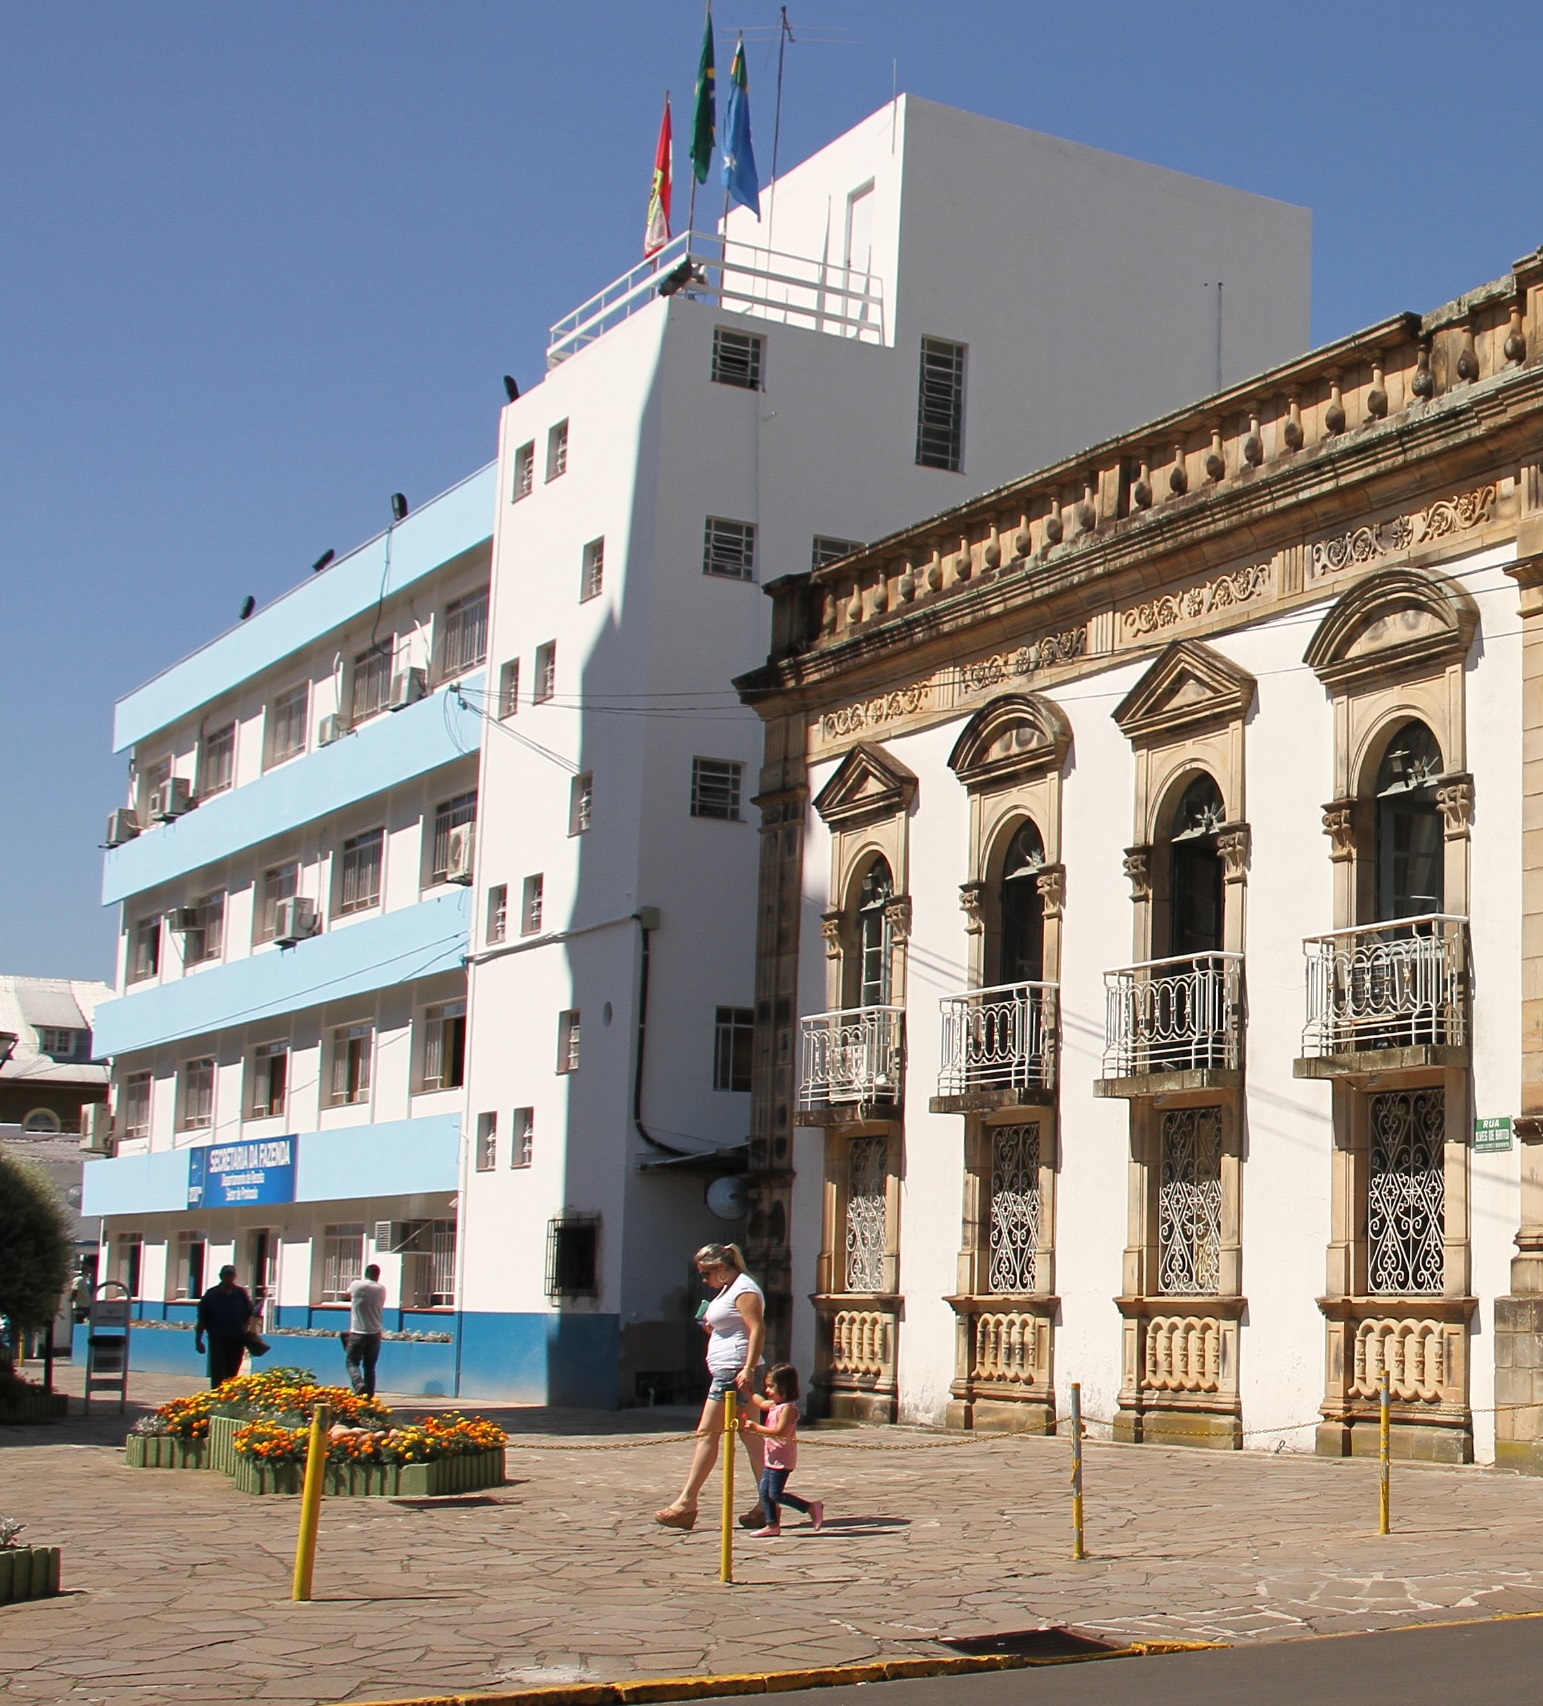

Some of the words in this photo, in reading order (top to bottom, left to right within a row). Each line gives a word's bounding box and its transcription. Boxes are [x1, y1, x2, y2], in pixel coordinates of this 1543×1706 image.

[1483, 1119, 1500, 1129] RUA
[1488, 1129, 1495, 1141] DE
[209, 1145, 249, 1173] SECRETARIA
[248, 1143, 259, 1169] DA
[259, 1140, 291, 1168] FAZENDA
